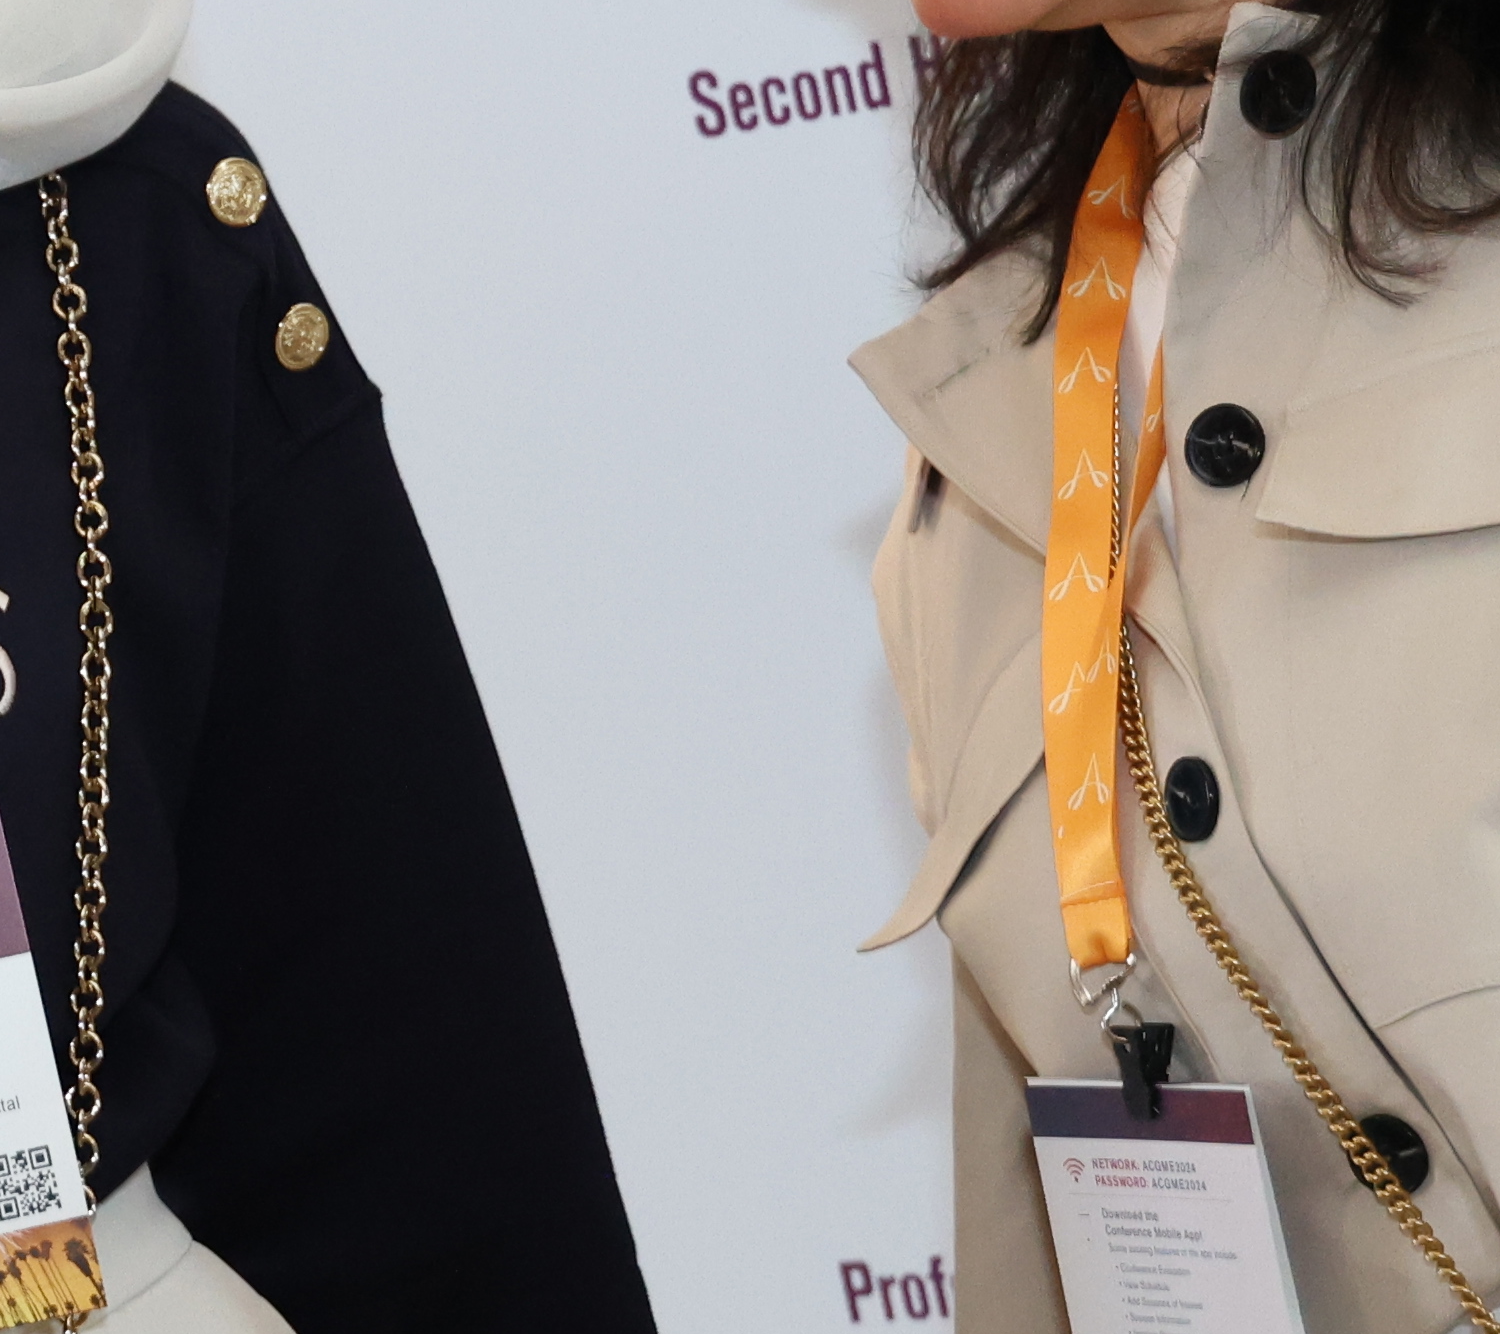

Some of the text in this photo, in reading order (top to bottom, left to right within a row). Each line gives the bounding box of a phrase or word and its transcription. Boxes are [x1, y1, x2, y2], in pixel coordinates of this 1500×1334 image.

[687, 39, 892, 138] Second
[1142, 1159, 1197, 1174] ACGME2024
[1151, 1177, 1207, 1191] ACGME2024
[838, 1253, 951, 1324] Prof
